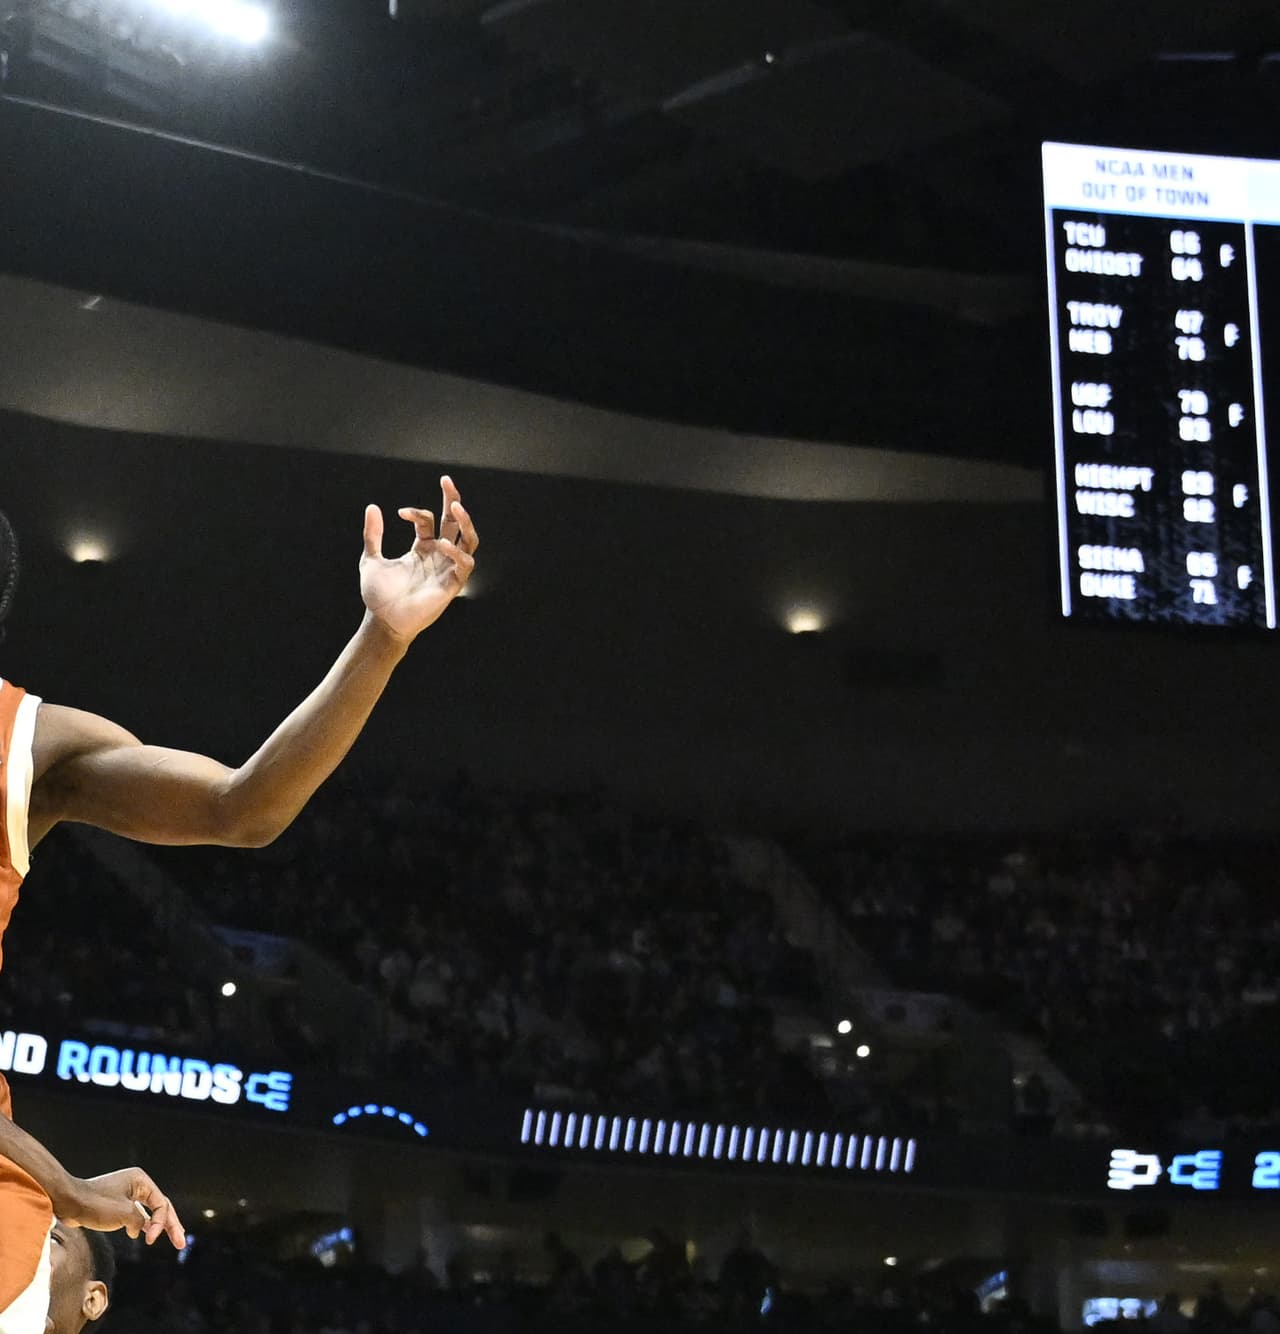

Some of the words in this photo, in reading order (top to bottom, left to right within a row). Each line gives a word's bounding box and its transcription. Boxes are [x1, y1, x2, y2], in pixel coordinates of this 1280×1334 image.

[1095, 158, 1145, 178] NCAA
[1151, 162, 1194, 182] MEN
[1082, 181, 1117, 200] OUT
[1125, 184, 1148, 203] OF
[1154, 187, 1210, 207] TOWN
[1064, 222, 1105, 247] TCU
[1067, 302, 1122, 328] TROY
[1073, 410, 1114, 435] LOU
[56, 1039, 243, 1105] ROUNDS
